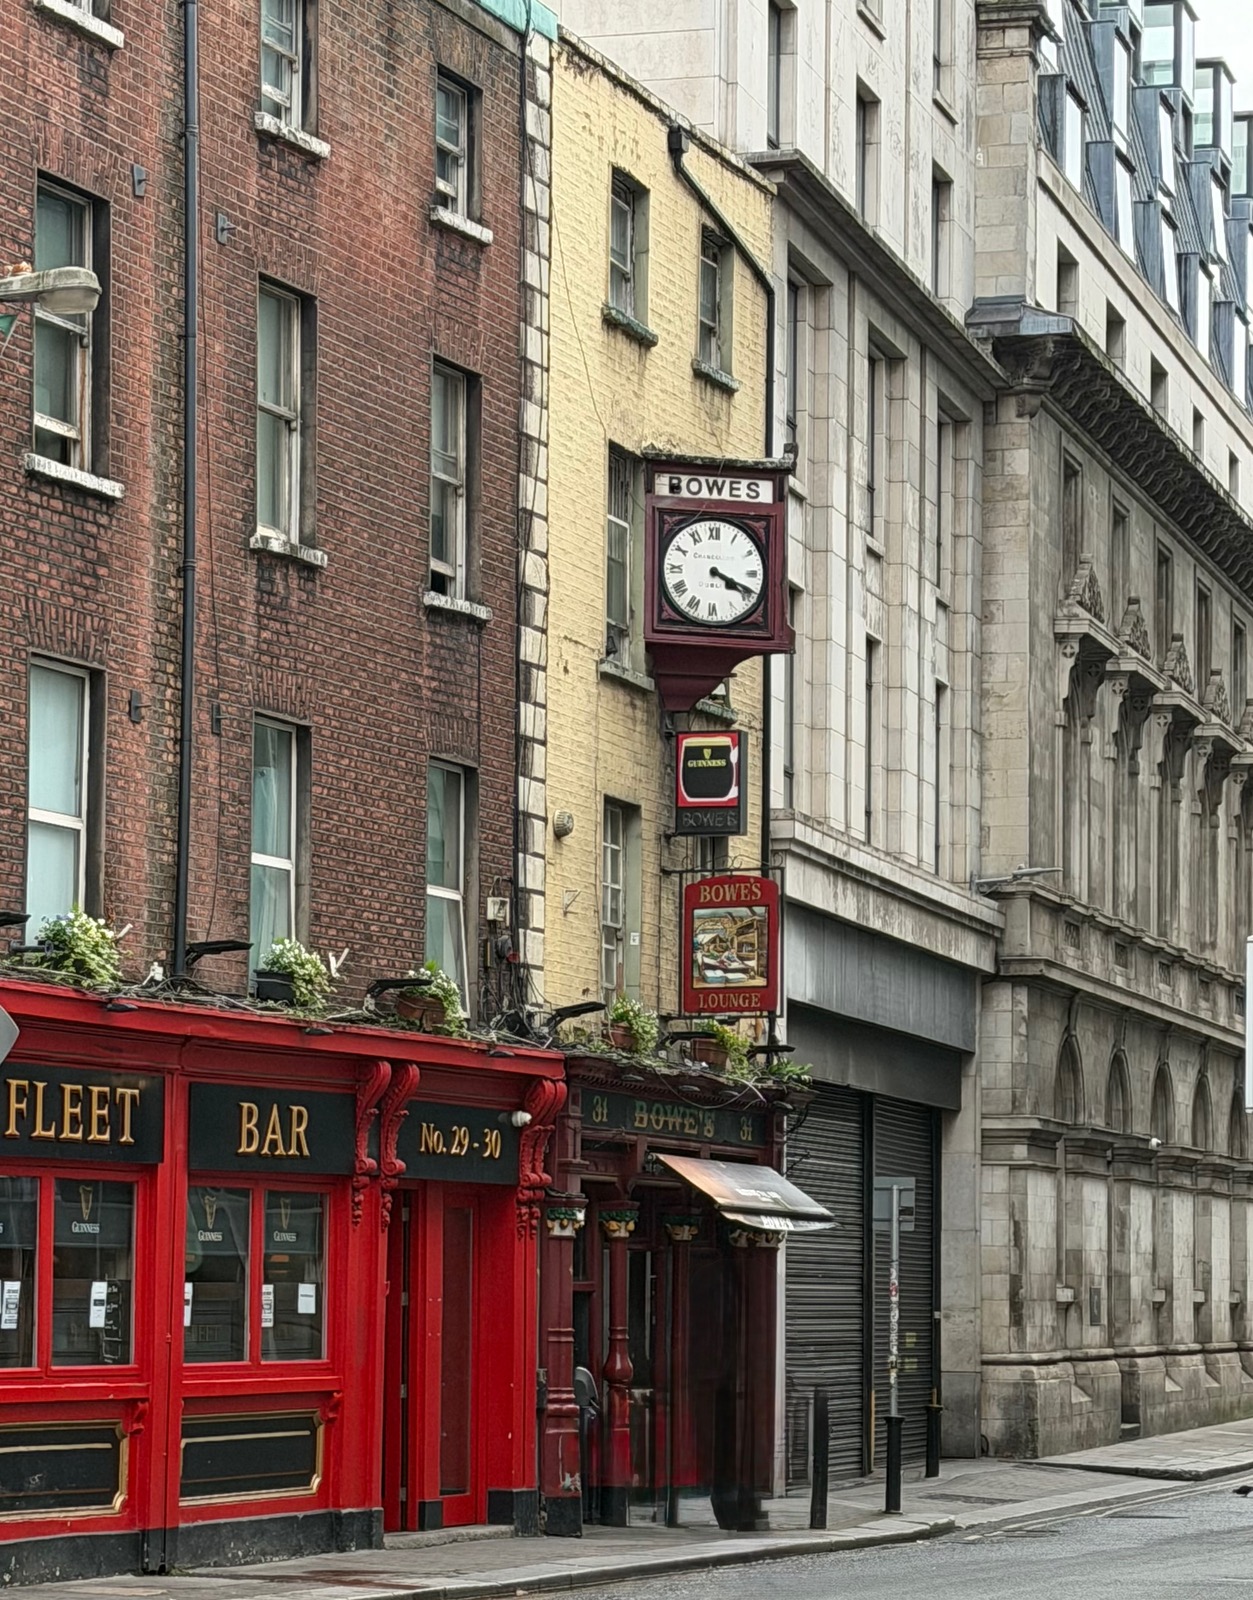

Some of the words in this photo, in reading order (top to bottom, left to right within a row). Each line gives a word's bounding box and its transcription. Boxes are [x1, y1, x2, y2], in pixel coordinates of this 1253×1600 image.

[668, 476, 761, 499] BOWES
[708, 526, 721, 541] XII
[687, 759, 727, 768] GUINNESS
[699, 878, 762, 903] BOWE'S
[698, 993, 761, 1009] LOUNGE
[4, 1078, 140, 1145] FLEET
[592, 1095, 609, 1124] 31
[634, 1100, 716, 1138] BOWE'S
[237, 1102, 311, 1158] BAR
[420, 1121, 448, 1155] No.
[740, 1116, 754, 1142] 31
